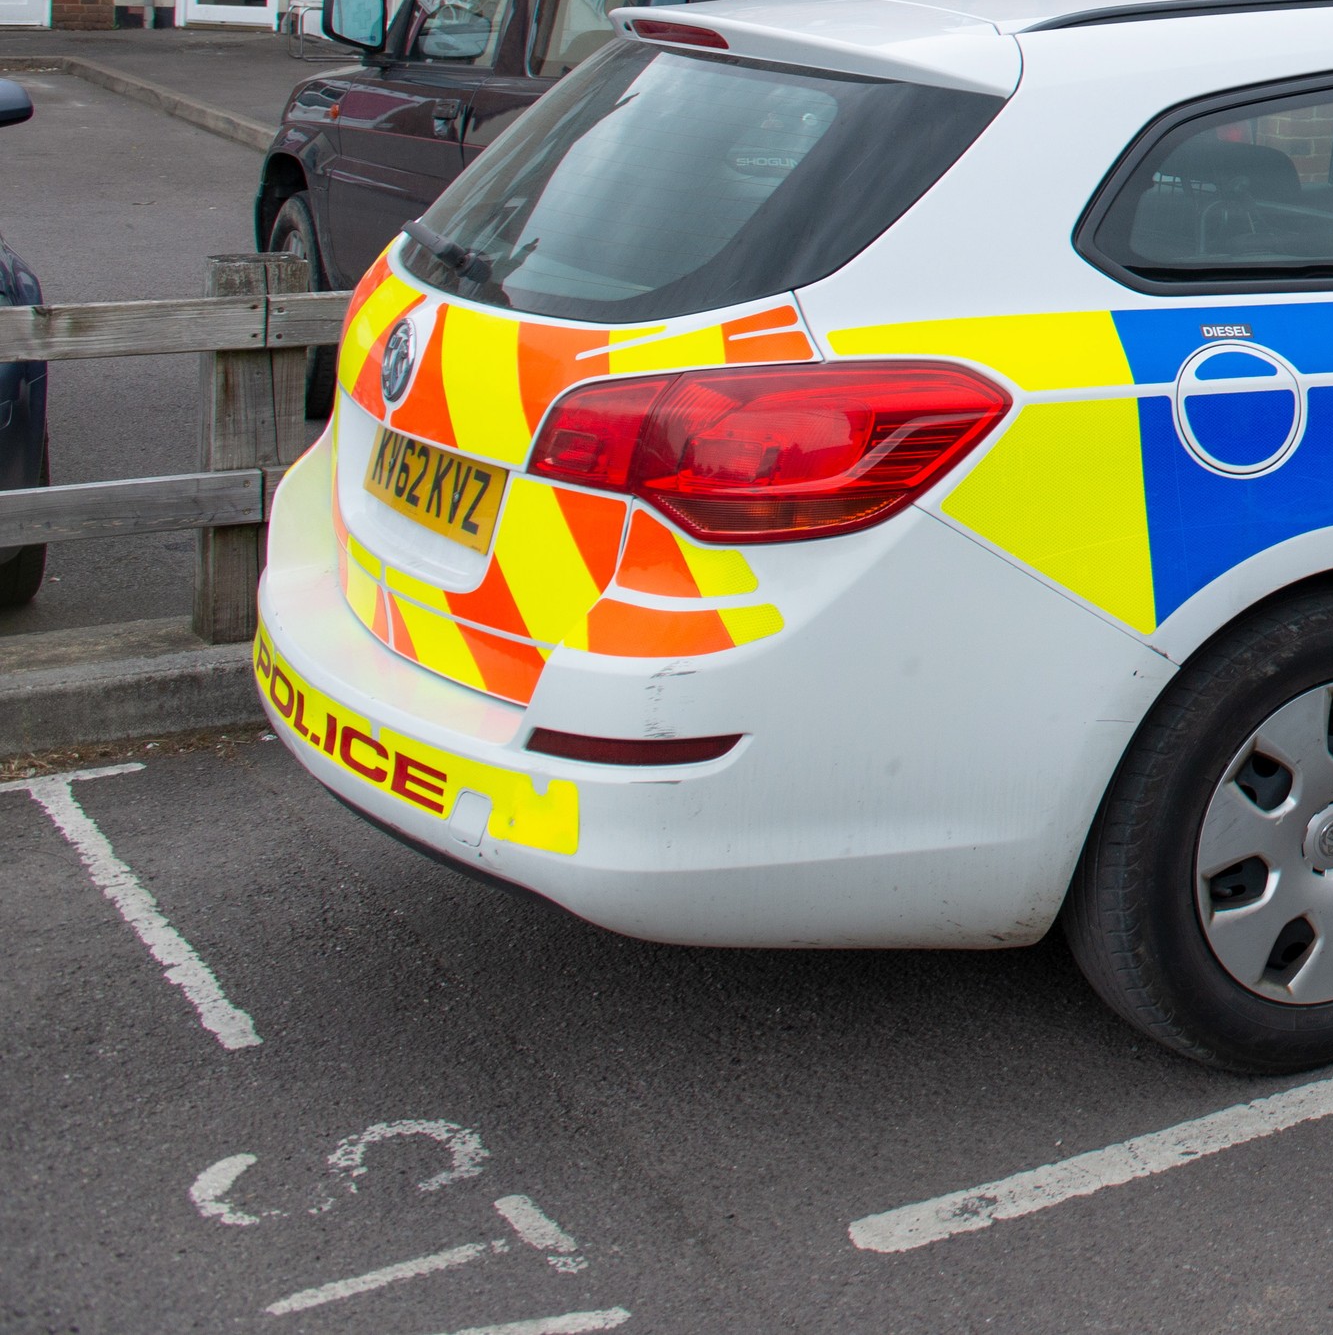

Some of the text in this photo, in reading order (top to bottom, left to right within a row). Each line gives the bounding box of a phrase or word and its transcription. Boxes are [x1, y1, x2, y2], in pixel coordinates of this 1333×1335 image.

[1203, 325, 1250, 338] DIESEL
[371, 428, 492, 535] KV62 KVZ
[254, 641, 448, 814] POLICE
